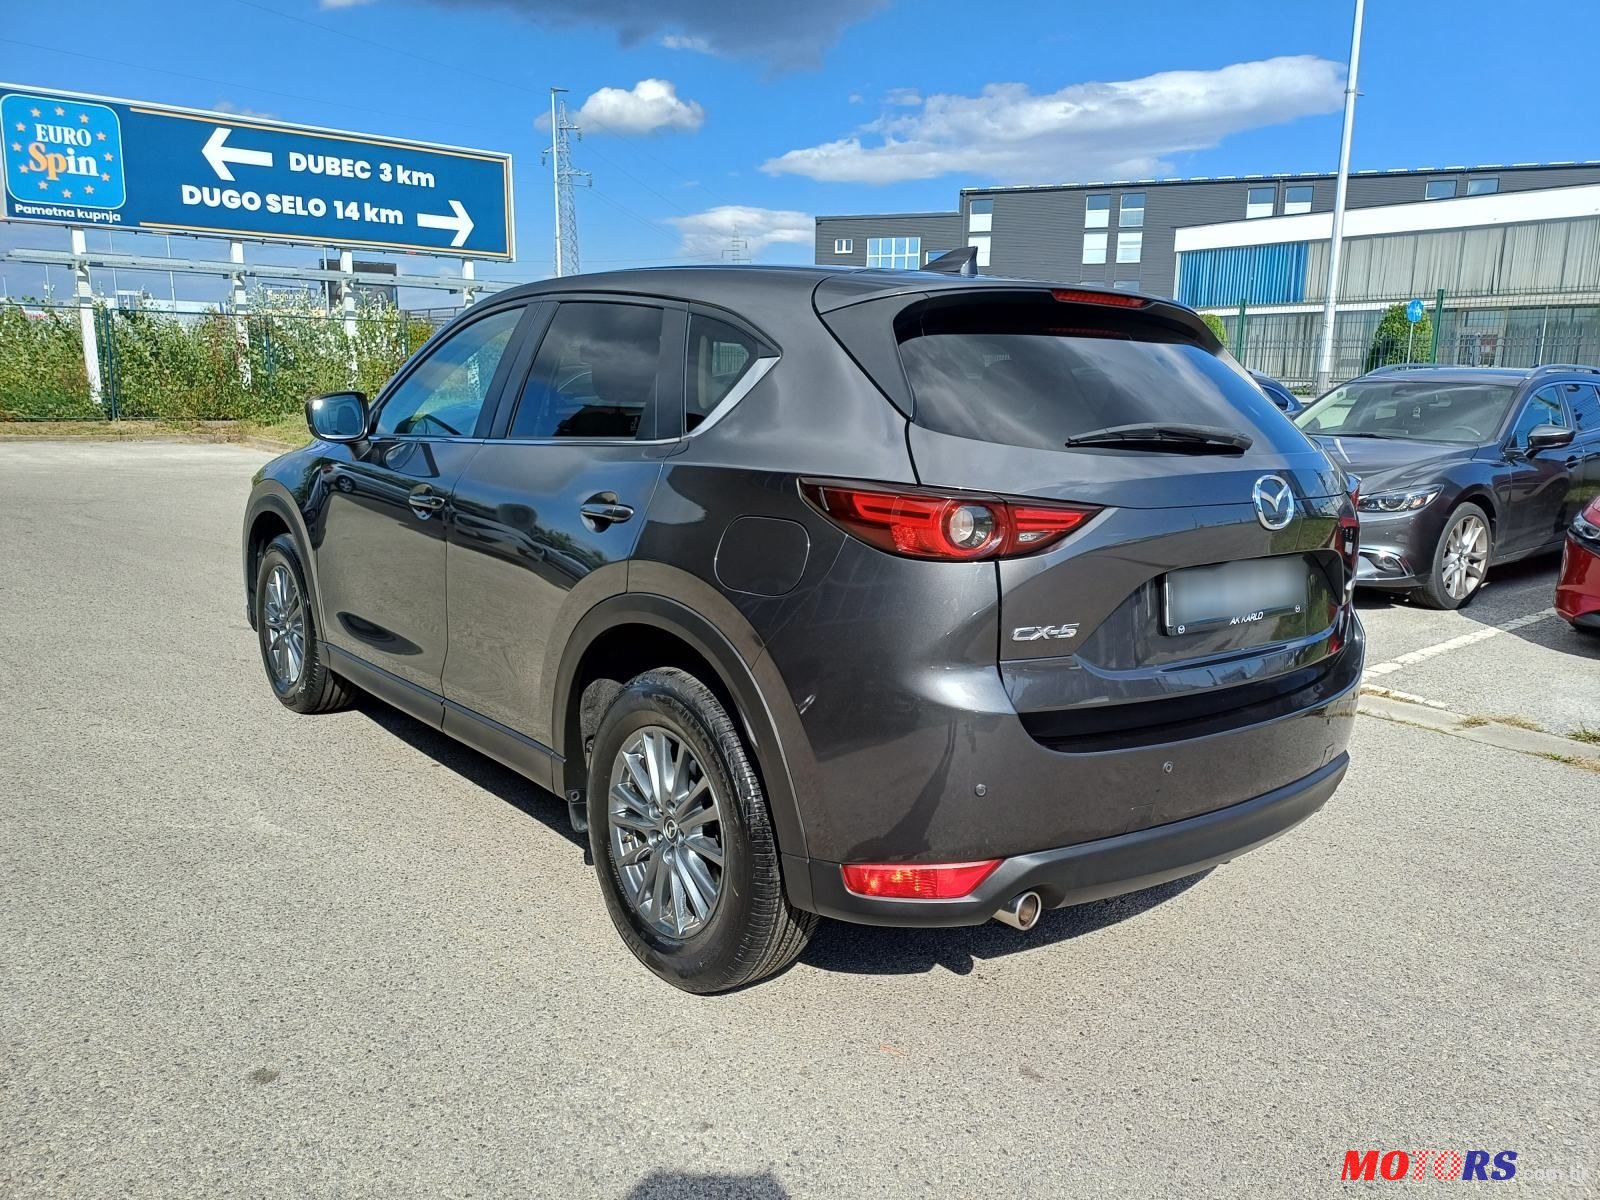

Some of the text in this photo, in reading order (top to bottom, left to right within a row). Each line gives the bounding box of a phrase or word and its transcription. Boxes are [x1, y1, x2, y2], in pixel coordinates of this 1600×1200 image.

[34, 123, 92, 147] EURO
[28, 142, 99, 181] Spin
[289, 152, 435, 188] DUBEC 3 km
[15, 203, 121, 223] Pametna kupnja
[181, 184, 403, 225] DUGO SELO 14 km
[1012, 623, 1080, 641] CX-5
